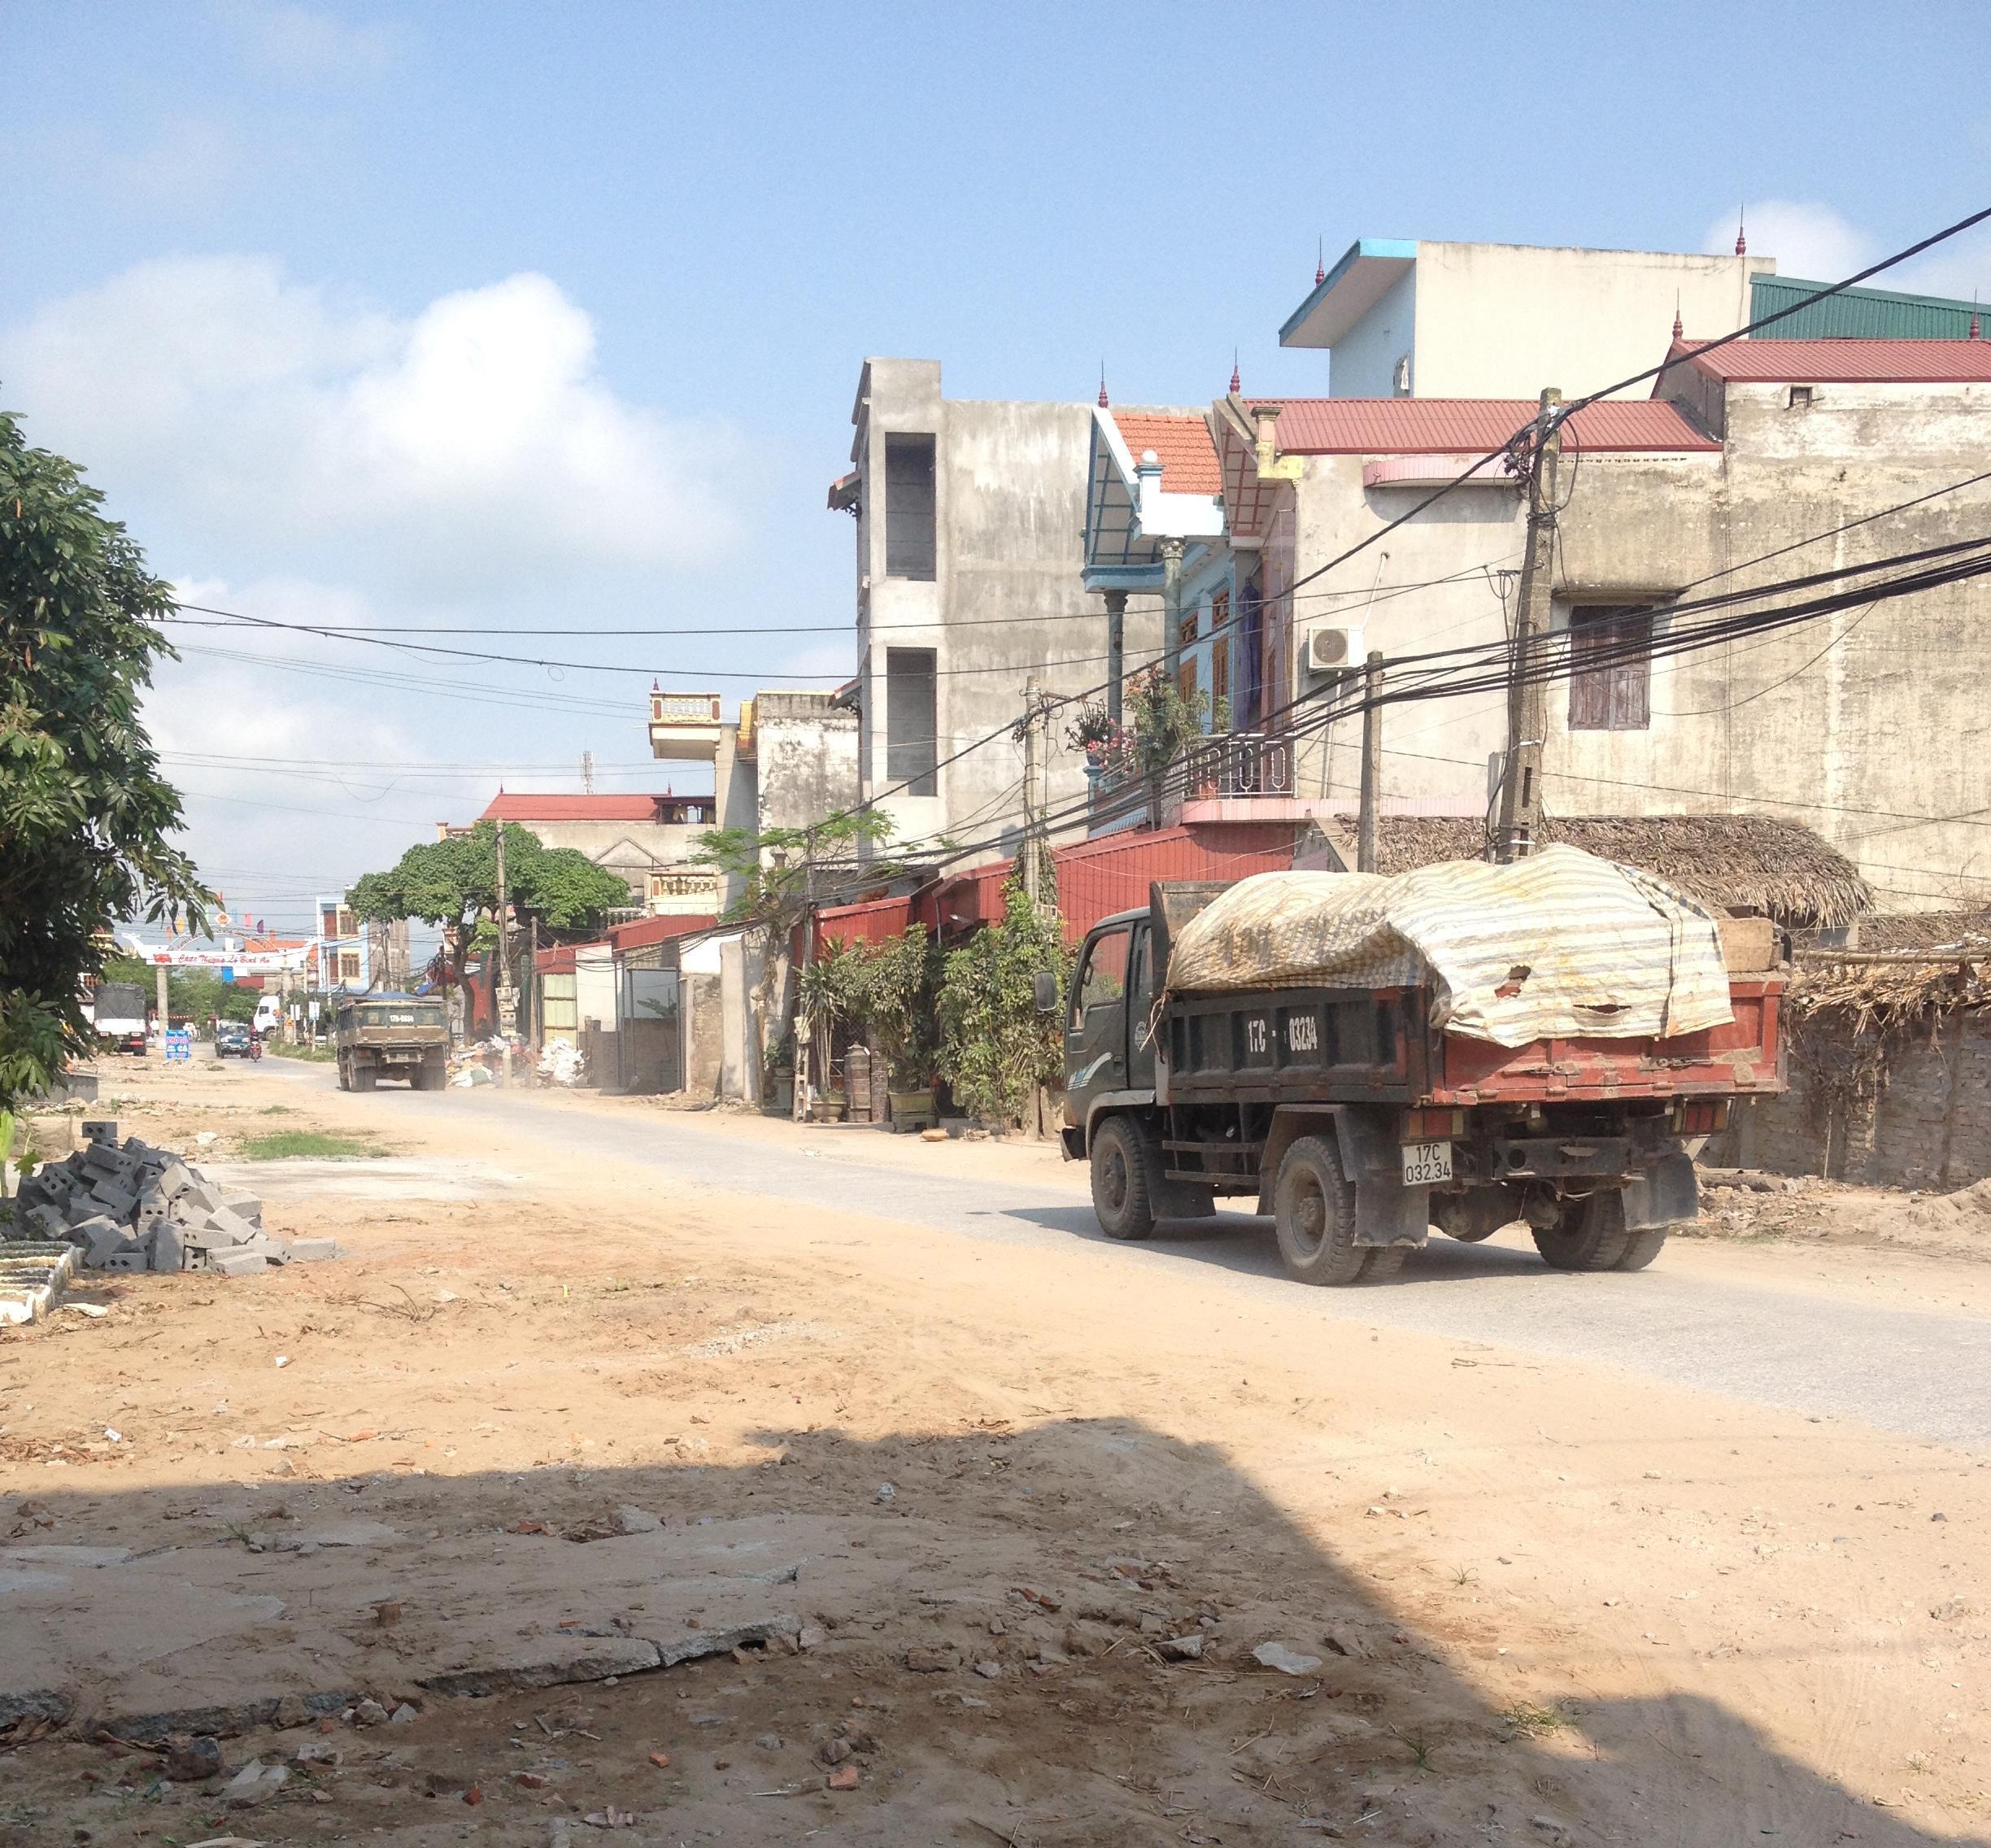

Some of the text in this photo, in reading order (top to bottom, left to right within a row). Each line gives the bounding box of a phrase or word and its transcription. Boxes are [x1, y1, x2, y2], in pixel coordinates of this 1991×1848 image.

[1248, 1019, 1266, 1052] 17C
[1289, 1016, 1318, 1051] 03234
[1416, 1144, 1440, 1163] 17C
[1405, 1161, 1451, 1183] 032.34
